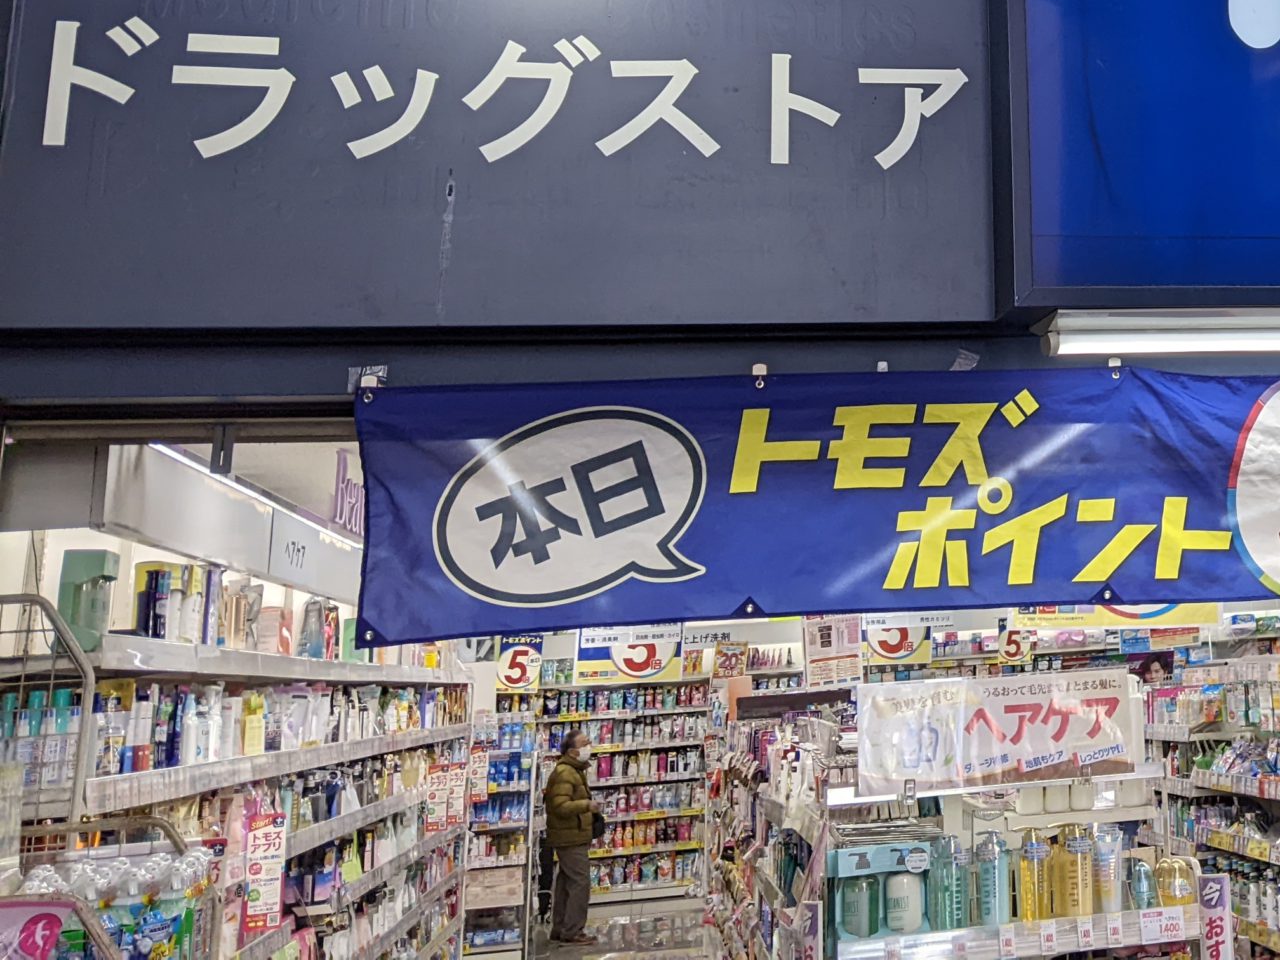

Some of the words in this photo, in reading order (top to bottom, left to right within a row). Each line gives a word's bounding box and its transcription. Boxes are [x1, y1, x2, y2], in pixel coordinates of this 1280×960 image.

[43, 15, 969, 169] ドラッグストア
[729, 388, 1039, 494] トモズ
[476, 440, 665, 569] 本日
[883, 477, 1232, 589] ポイント
[504, 650, 529, 684] 5
[964, 696, 1121, 745] ヘアケア
[250, 842, 282, 855] アプリ
[251, 830, 284, 843] トモズ
[1202, 880, 1221, 906] 今
